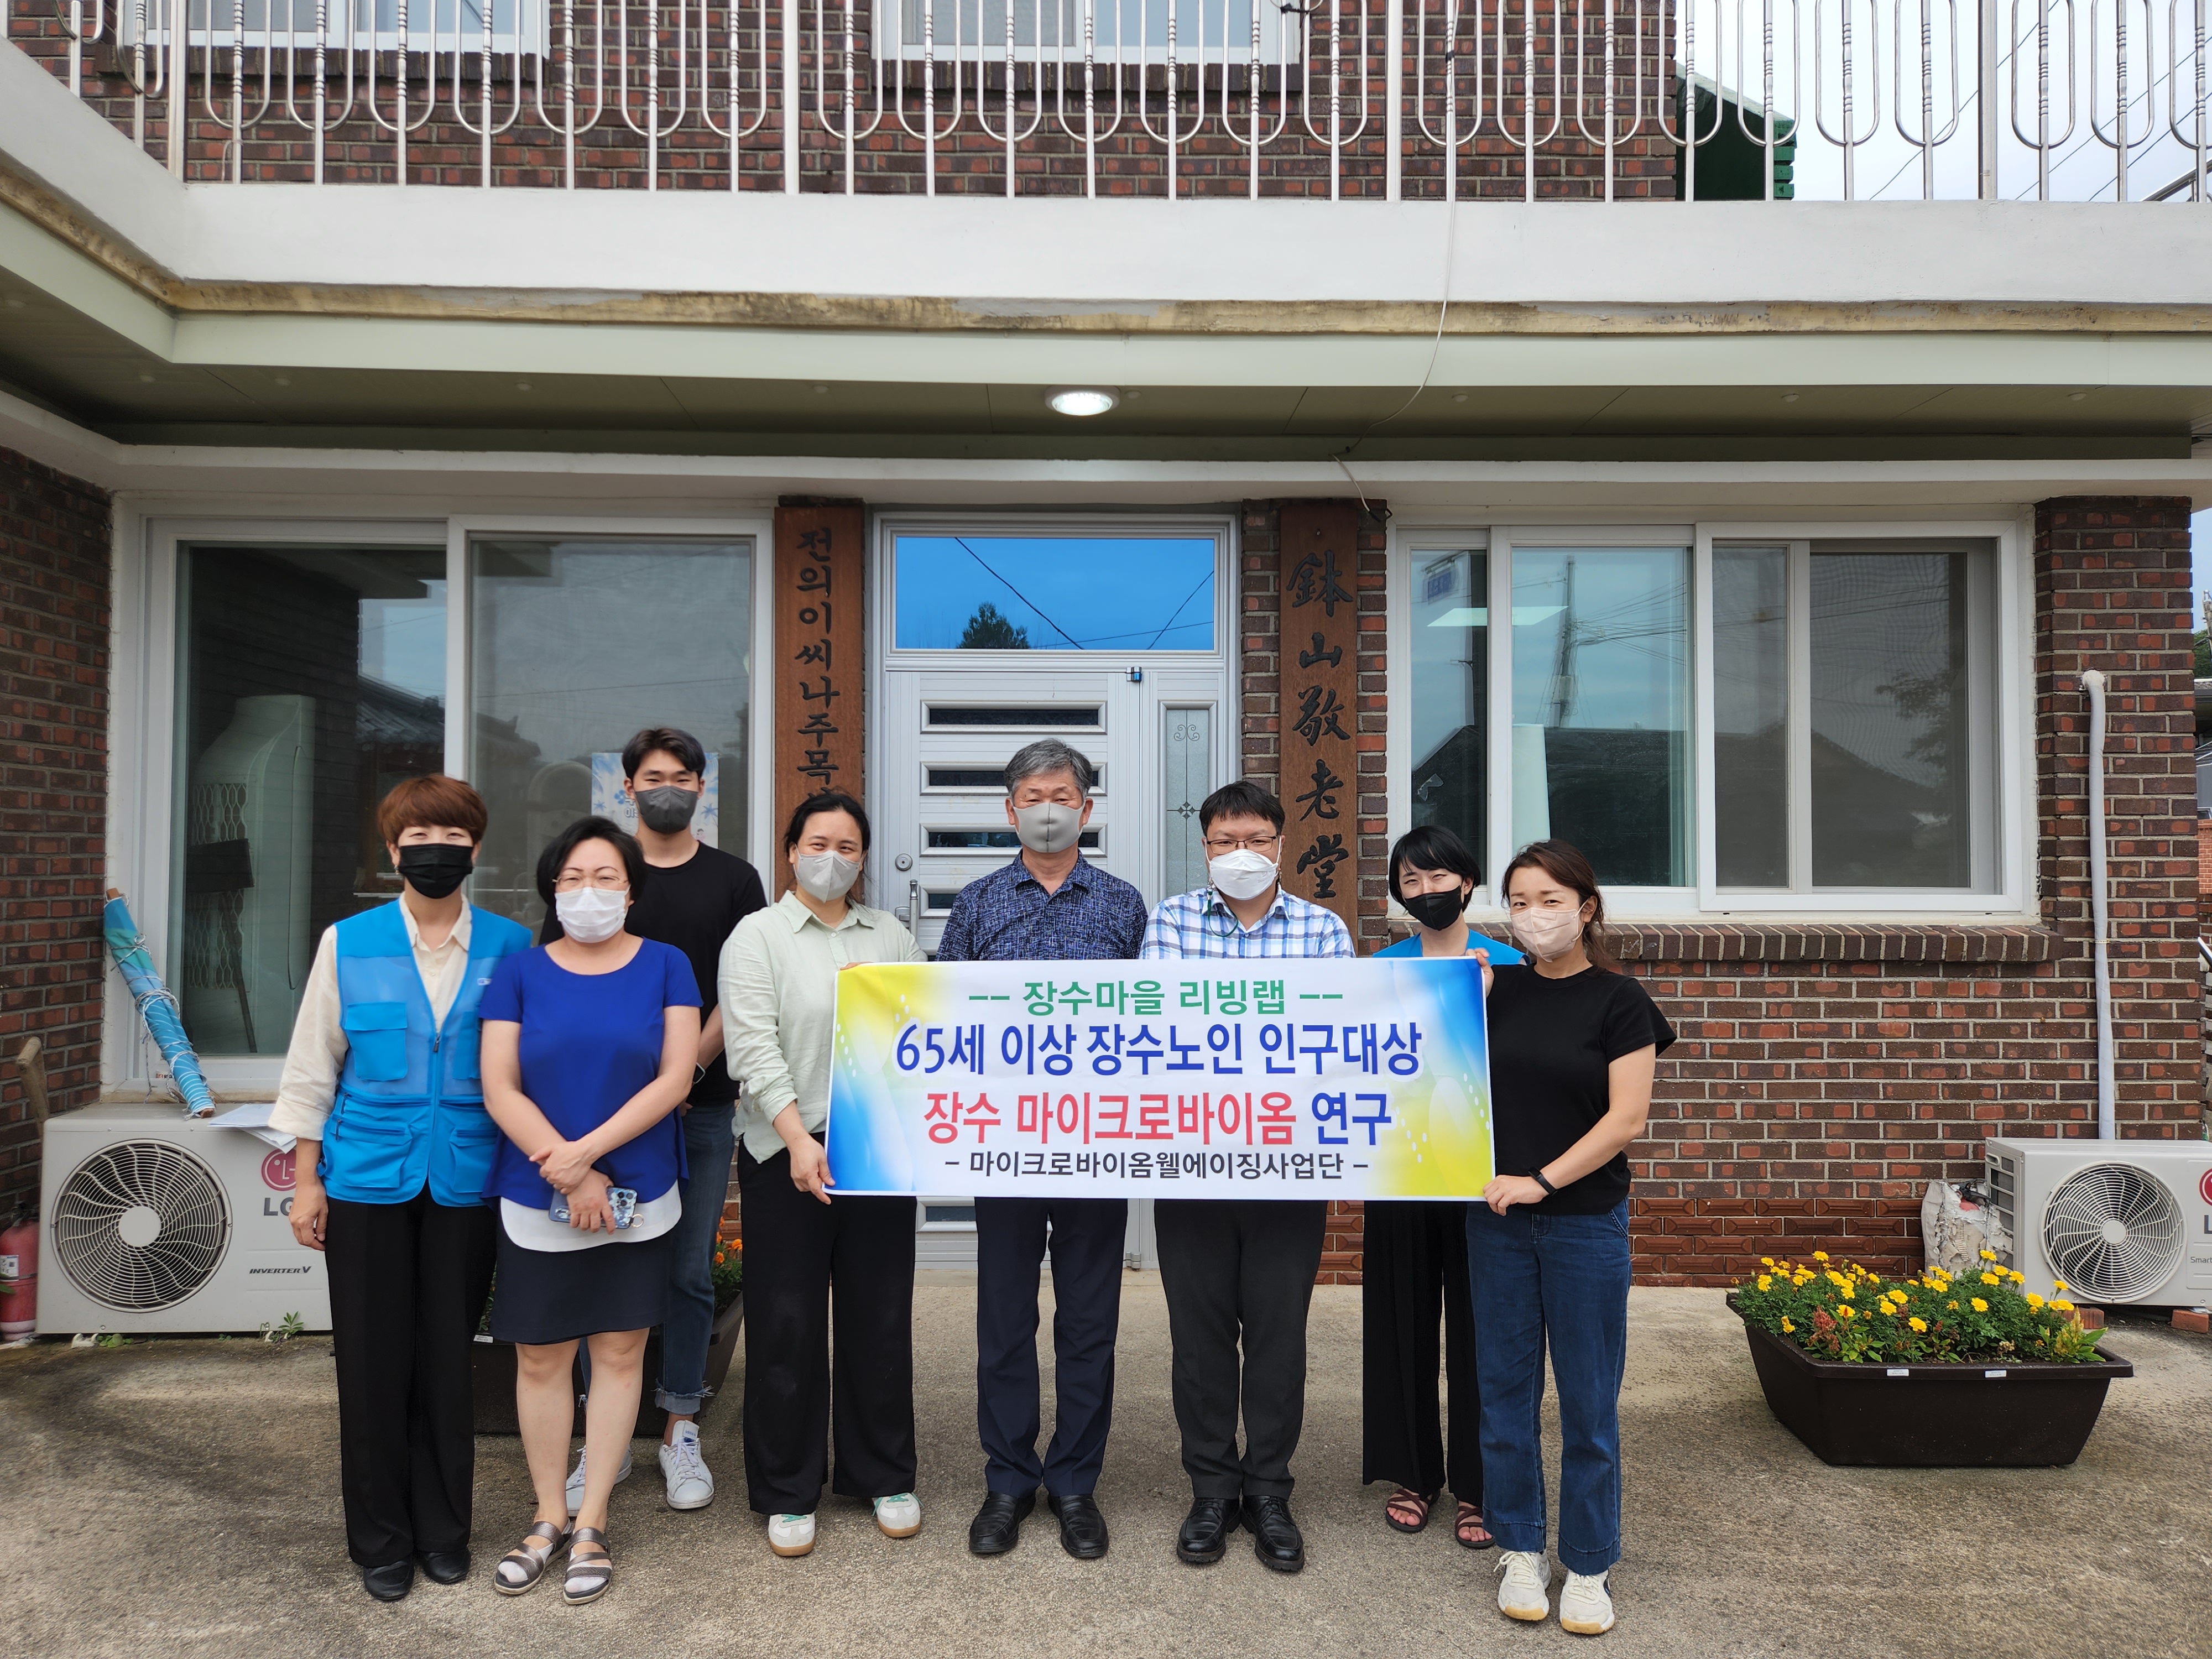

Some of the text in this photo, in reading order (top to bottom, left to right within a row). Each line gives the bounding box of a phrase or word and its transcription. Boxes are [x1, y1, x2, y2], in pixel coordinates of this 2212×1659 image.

[795, 527, 840, 797] 전의이씨나주목
[1286, 550, 1354, 899] 鉢山敬老堂
[1023, 979, 1165, 1016] 장수마을
[1179, 979, 1285, 1016] 리빙랩
[896, 1022, 1422, 1076] 65세 이상 장수노인 인구대상
[924, 1092, 1392, 1146] 장수 마이크로바이옴 연구
[971, 1151, 1344, 1180] 마이크로바이옴웰에이징사업단
